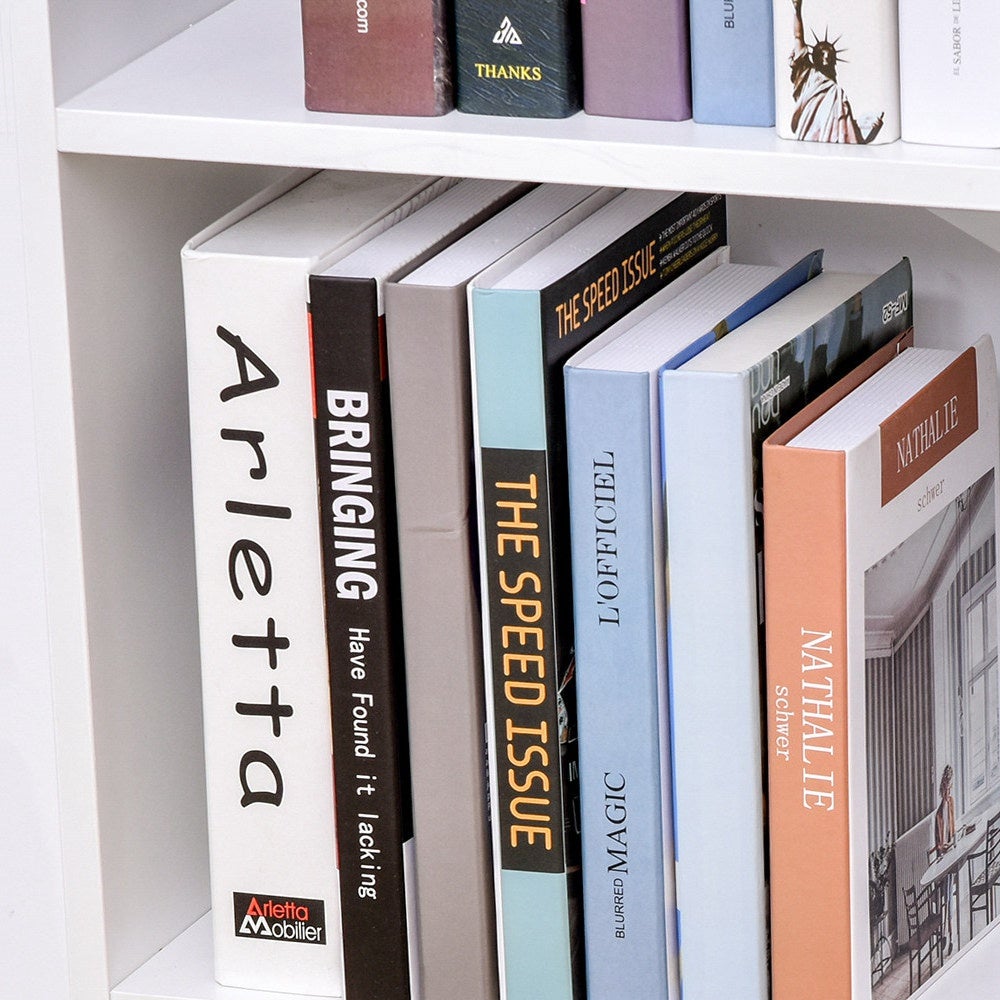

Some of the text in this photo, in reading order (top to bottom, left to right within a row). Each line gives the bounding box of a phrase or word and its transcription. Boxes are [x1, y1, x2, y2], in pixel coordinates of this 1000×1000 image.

[474, 63, 542, 81] THANKS
[952, 27, 961, 64] SABOR
[555, 293, 581, 339] THE
[583, 267, 620, 323] SPEED
[621, 240, 657, 296] ISSUE
[896, 395, 959, 474] NATHALIE
[592, 450, 621, 628] L'OFFICIEL
[917, 479, 945, 512] schwer
[216, 325, 294, 808] Arletta
[326, 389, 381, 900] BRINGING Have Found it lacking
[495, 474, 552, 852] THE SPEED ISSUE
[775, 685, 790, 761] schwer
[801, 626, 835, 812] NATHALIE
[603, 771, 629, 939] BLURRED MAGIC
[238, 914, 323, 942] Mobilier
[246, 896, 310, 922] Arletta
